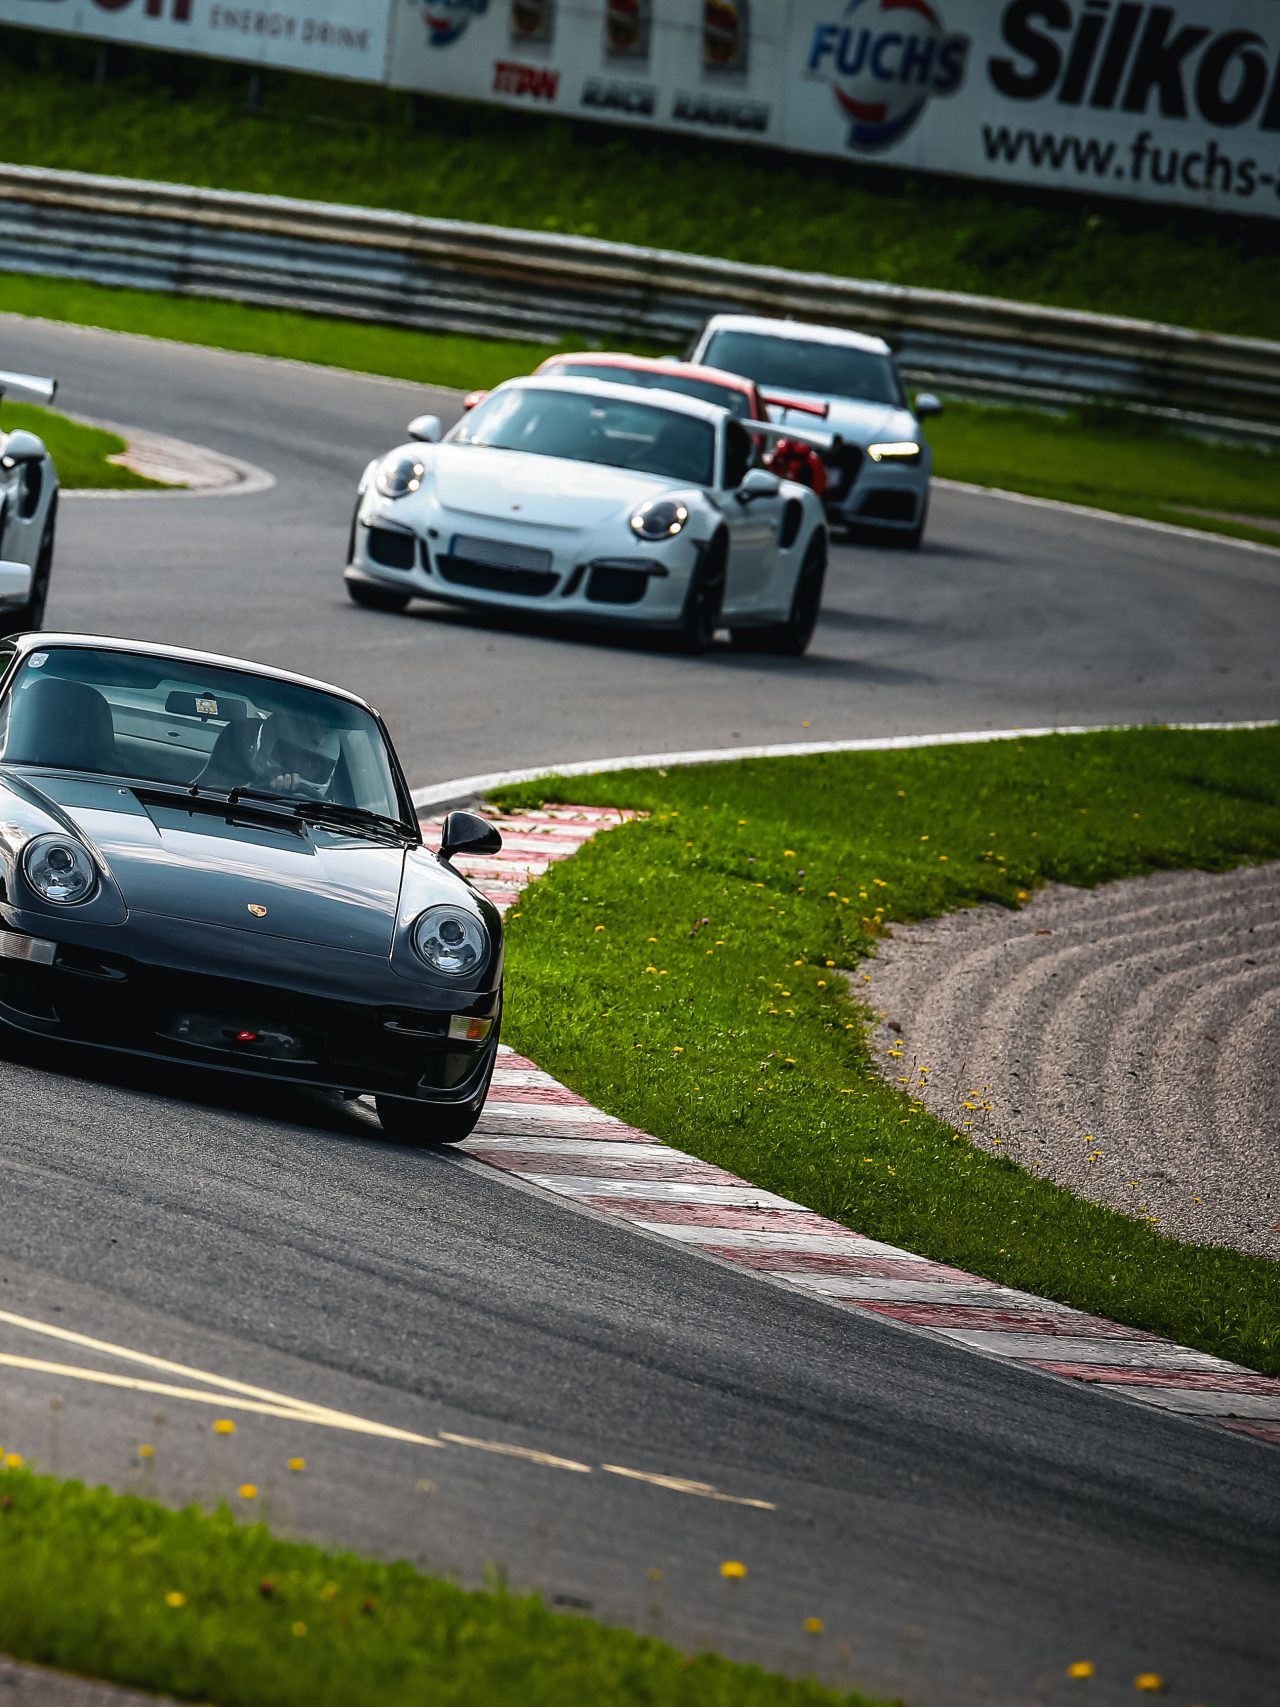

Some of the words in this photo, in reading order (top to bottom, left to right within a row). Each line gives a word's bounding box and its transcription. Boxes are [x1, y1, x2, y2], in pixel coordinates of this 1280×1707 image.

[207, 5, 300, 40] ENERGY
[302, 17, 371, 53] DRINK
[808, 22, 969, 93] FUCHS
[581, 77, 658, 116] RACE
[981, 124, 1280, 200] www.fuchs-
